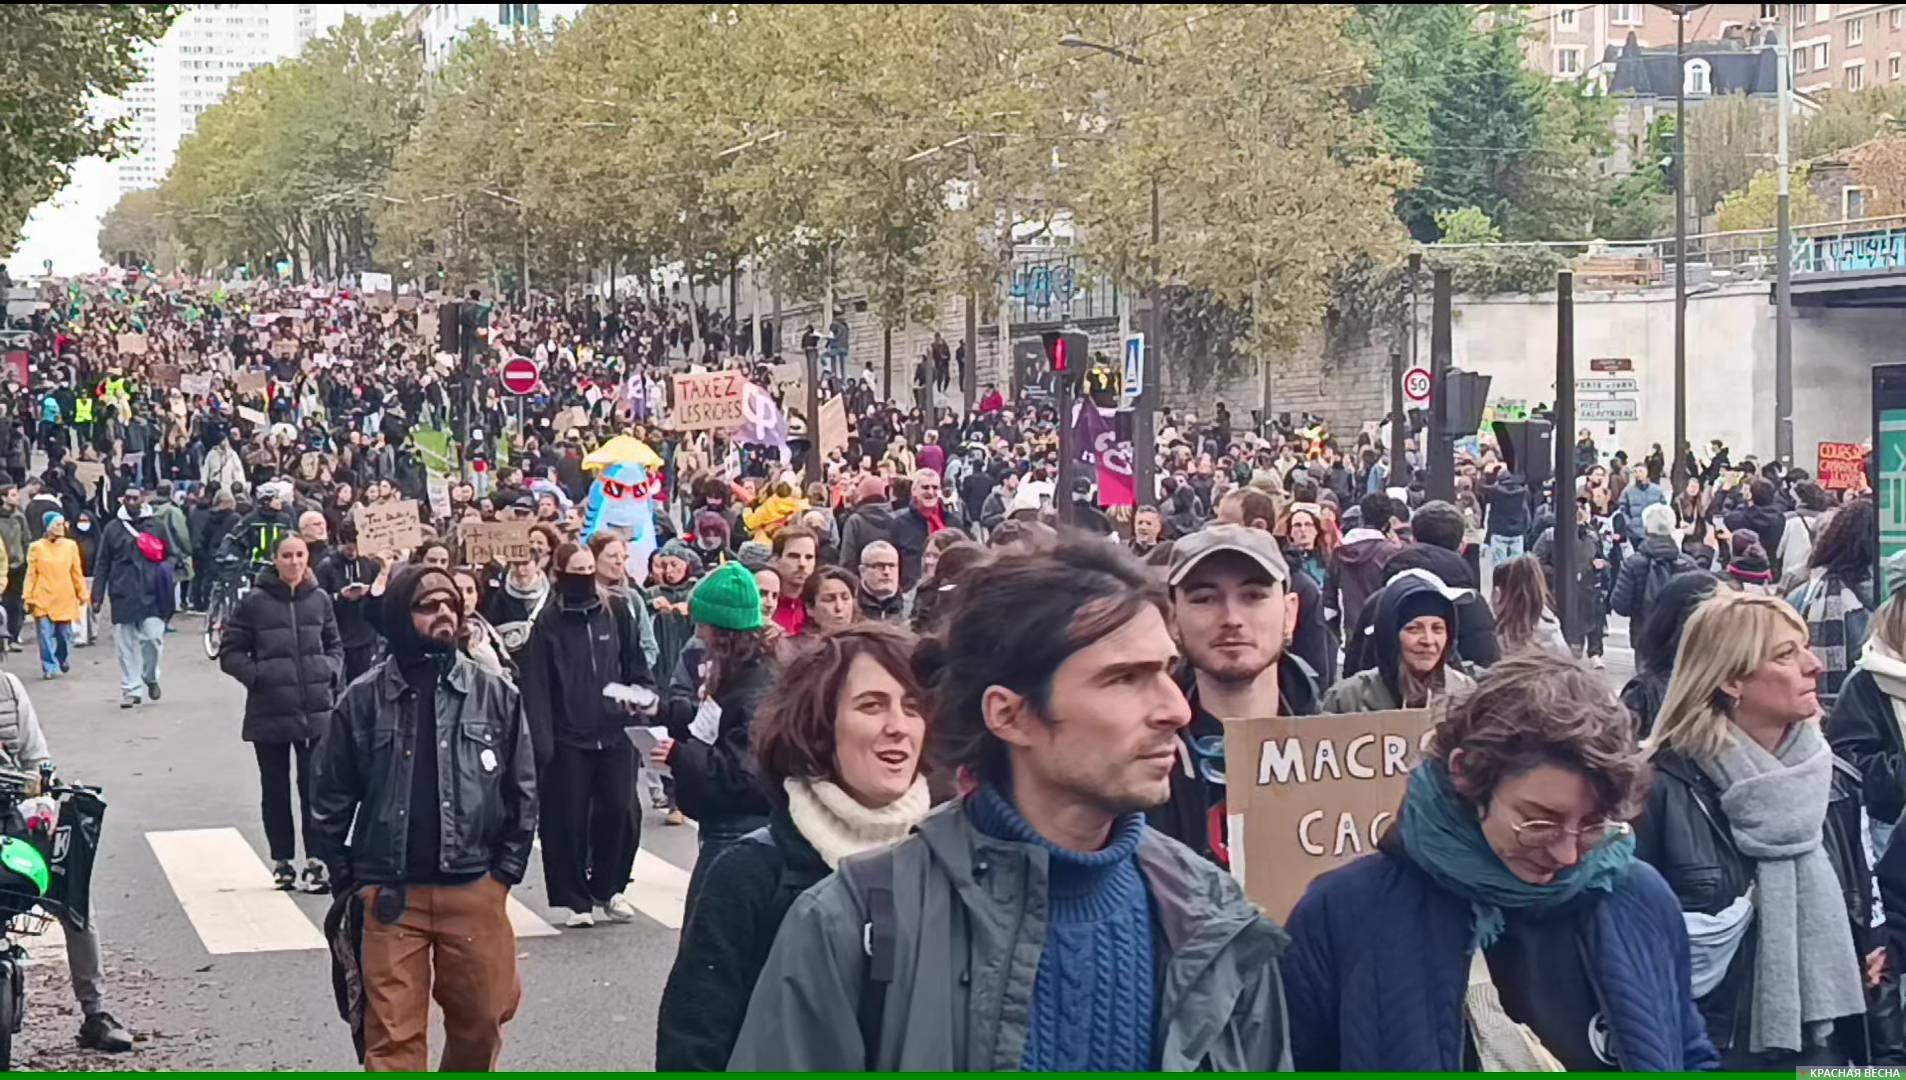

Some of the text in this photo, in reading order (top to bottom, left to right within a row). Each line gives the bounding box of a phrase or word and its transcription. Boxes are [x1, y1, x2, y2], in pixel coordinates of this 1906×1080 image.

[678, 376, 737, 400] TAXEZ
[1410, 378, 1427, 392] 50
[679, 400, 742, 424] LES RICHES
